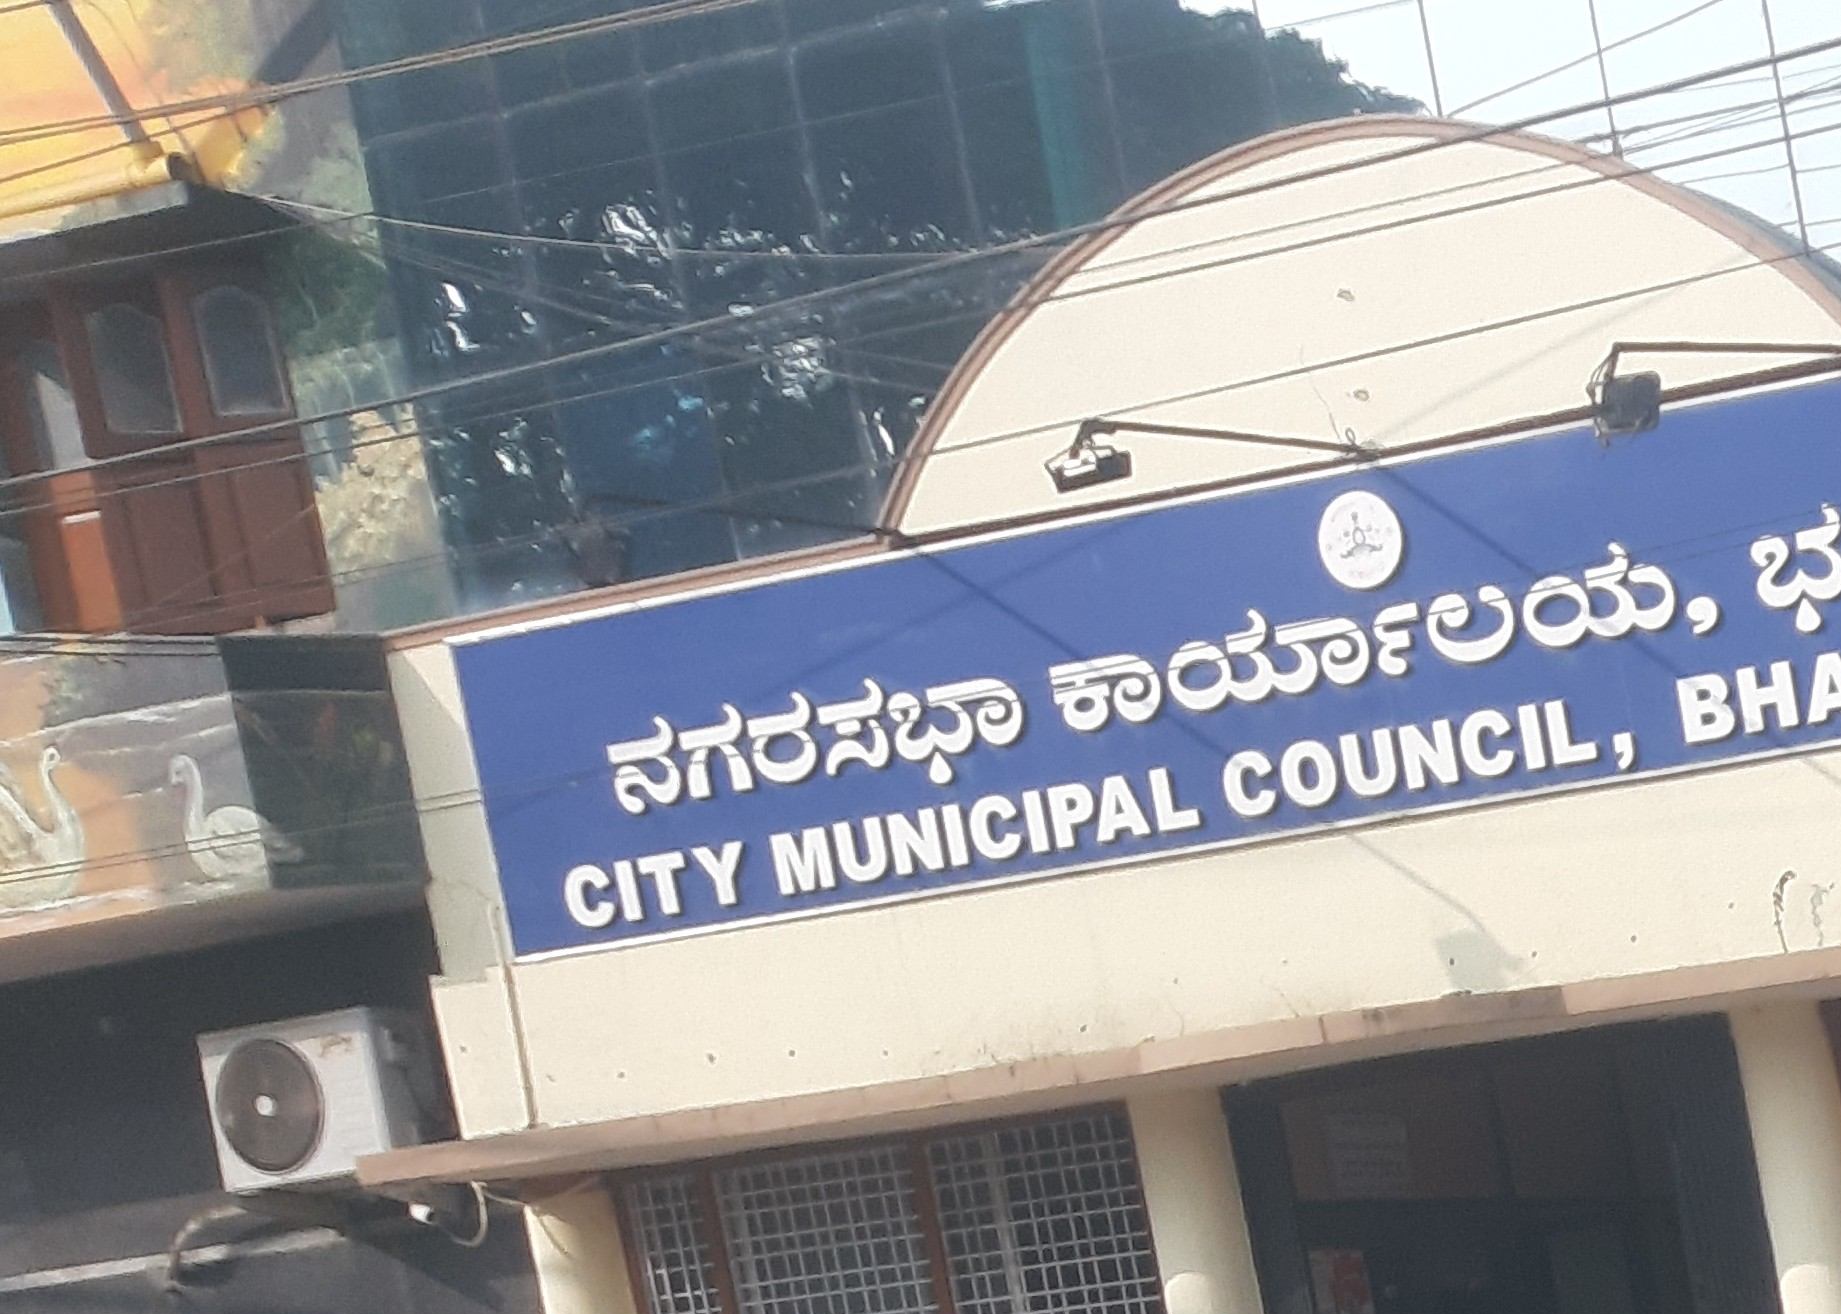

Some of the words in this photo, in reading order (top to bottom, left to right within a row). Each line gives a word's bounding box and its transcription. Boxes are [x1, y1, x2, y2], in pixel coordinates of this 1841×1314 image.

[606, 678, 1022, 815] ನಗರಸಭಾ
[1049, 541, 1719, 732] ಕಾರ್ಯಾಲಯ,
[563, 839, 747, 929] CITY
[771, 765, 1199, 896] MUNICIPAL
[1223, 702, 1637, 817] COUNCIL,
